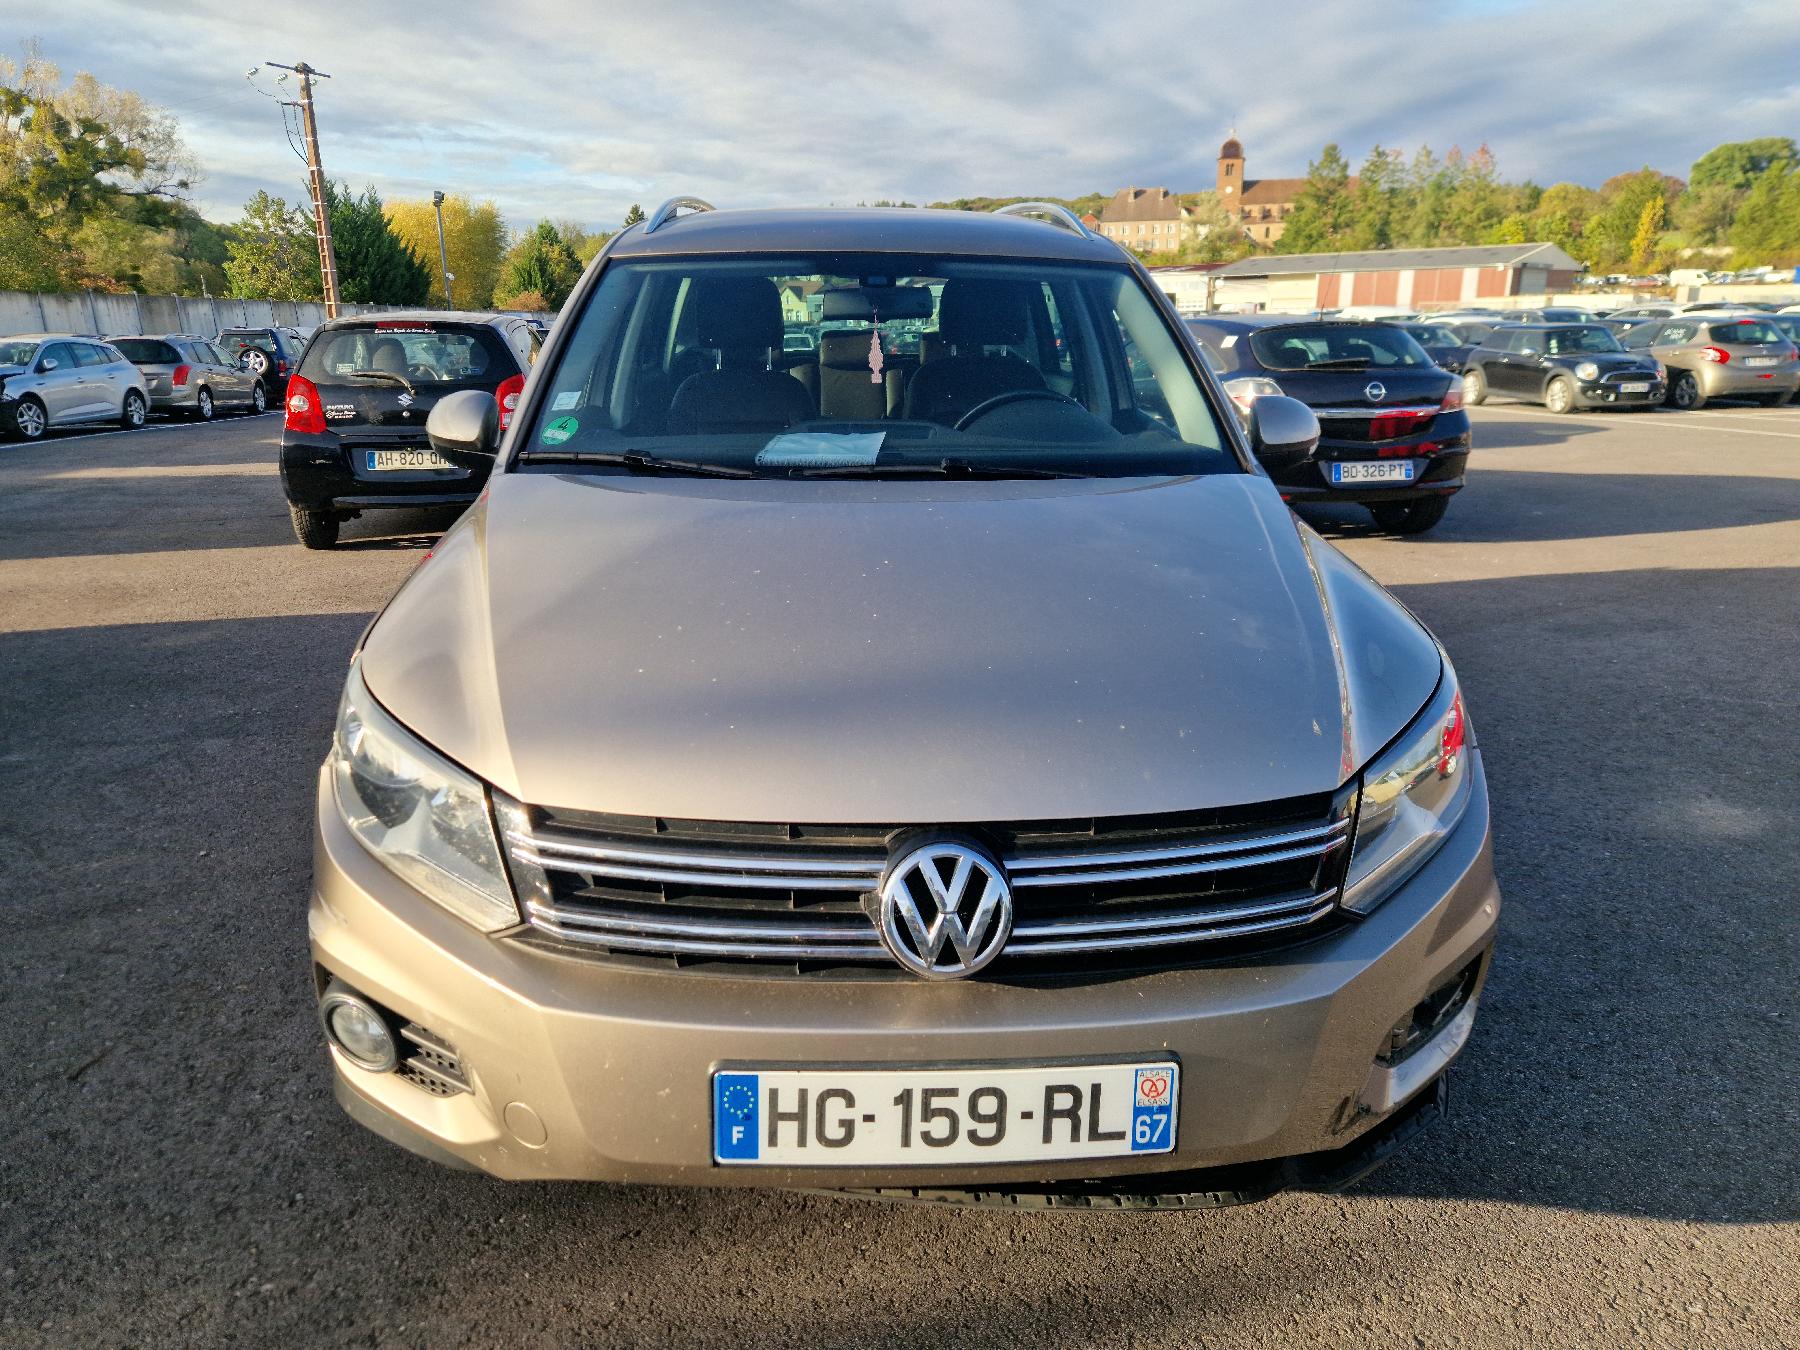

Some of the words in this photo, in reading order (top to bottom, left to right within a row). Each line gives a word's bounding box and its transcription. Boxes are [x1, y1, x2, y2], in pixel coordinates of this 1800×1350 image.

[1139, 1070, 1171, 1078] ALSACE
[1137, 1098, 1168, 1106] ELSASS
[767, 1083, 1127, 1148] HG-159-RL
[732, 1126, 744, 1145] F
[1135, 1113, 1168, 1144] 67
